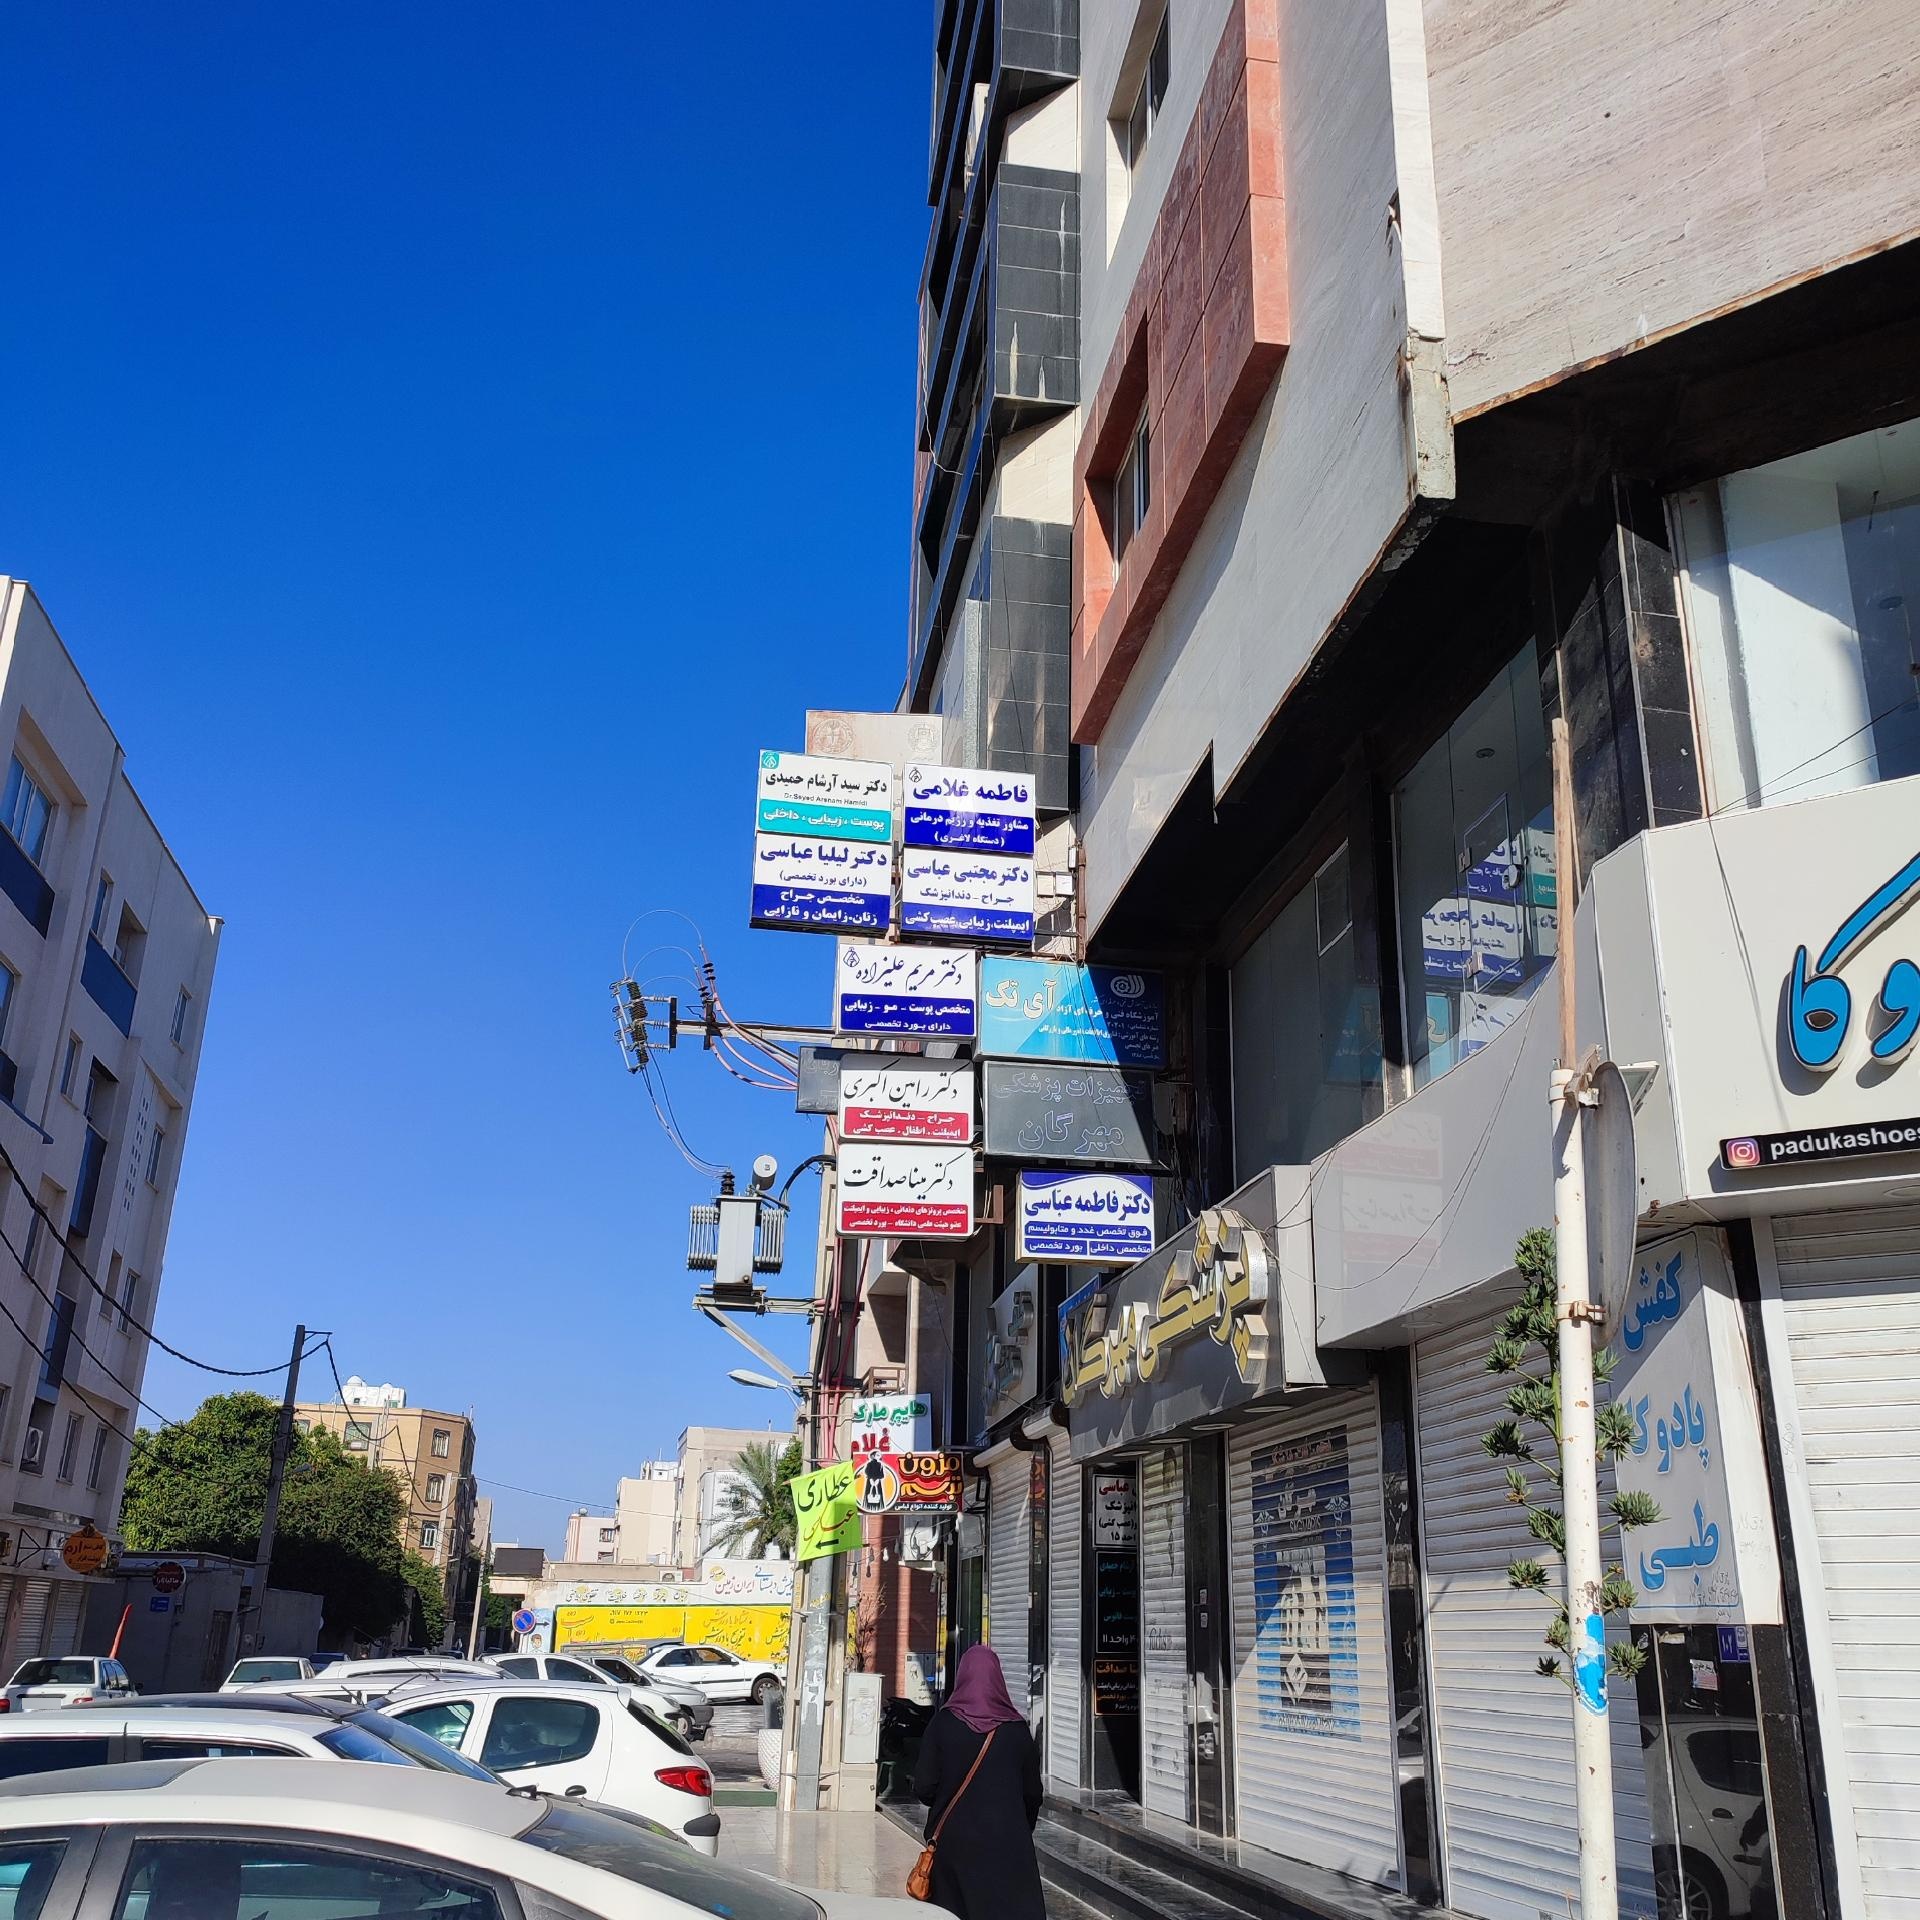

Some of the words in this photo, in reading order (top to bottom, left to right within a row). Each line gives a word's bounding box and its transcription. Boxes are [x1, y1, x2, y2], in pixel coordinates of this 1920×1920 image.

[766, 772, 803, 786] حمیدی
[841, 780, 859, 792] سید
[864, 779, 887, 795] دکتر
[913, 778, 969, 800] غلامی
[976, 782, 1028, 803] فاطمه
[910, 812, 944, 825] درمانی
[976, 816, 1000, 828] تغذیه
[1002, 819, 1029, 831] مشاور
[760, 842, 813, 864] عباسی
[818, 845, 849, 867] لیلیا
[850, 850, 887, 869] دکتر
[907, 859, 951, 880] عباسی
[954, 865, 998, 884] مجتبی
[998, 866, 1029, 886] دکتر
[818, 876, 837, 885] بورد
[780, 888, 815, 904] جراح
[816, 894, 865, 905] متخصص
[856, 956, 905, 987] علیزاده
[906, 964, 935, 993] مریم
[934, 952, 969, 988] دکتر
[986, 980, 1019, 1008] تک
[1023, 978, 1057, 1019] آی
[844, 1000, 874, 1013] زیبایی
[909, 1003, 934, 1015] پوست
[935, 1004, 971, 1015] متخصص
[1056, 1004, 1072, 1015] آزاد
[864, 1020, 901, 1029] تخصصی
[903, 1021, 926, 1031] بورد
[928, 1022, 952, 1031] دارای
[844, 1058, 901, 1102] اکبری
[928, 1060, 971, 1102] دکتر
[993, 1073, 1061, 1104] پزشکی
[888, 1080, 930, 1108] رامین
[844, 1156, 907, 1189] صداقت
[922, 1152, 967, 1193] دکتر
[1074, 1190, 1119, 1214] فاطمه
[1118, 1193, 1151, 1221] دکتر
[1028, 1224, 1069, 1235] متابولیسم
[1077, 1226, 1095, 1234] غدد
[1096, 1228, 1127, 1237] تخصص
[1128, 1228, 1148, 1238] فوق
[1029, 1242, 1063, 1251] تخصصی
[1064, 1244, 1084, 1253] بورد
[1090, 1244, 1115, 1254] داخلی
[1116, 1246, 1151, 1255] متخصص
[1622, 1250, 1685, 1352] کفش
[898, 1452, 960, 1477] مزون
[798, 1472, 852, 1513] عطاری
[1639, 1498, 1722, 1593] طبی
